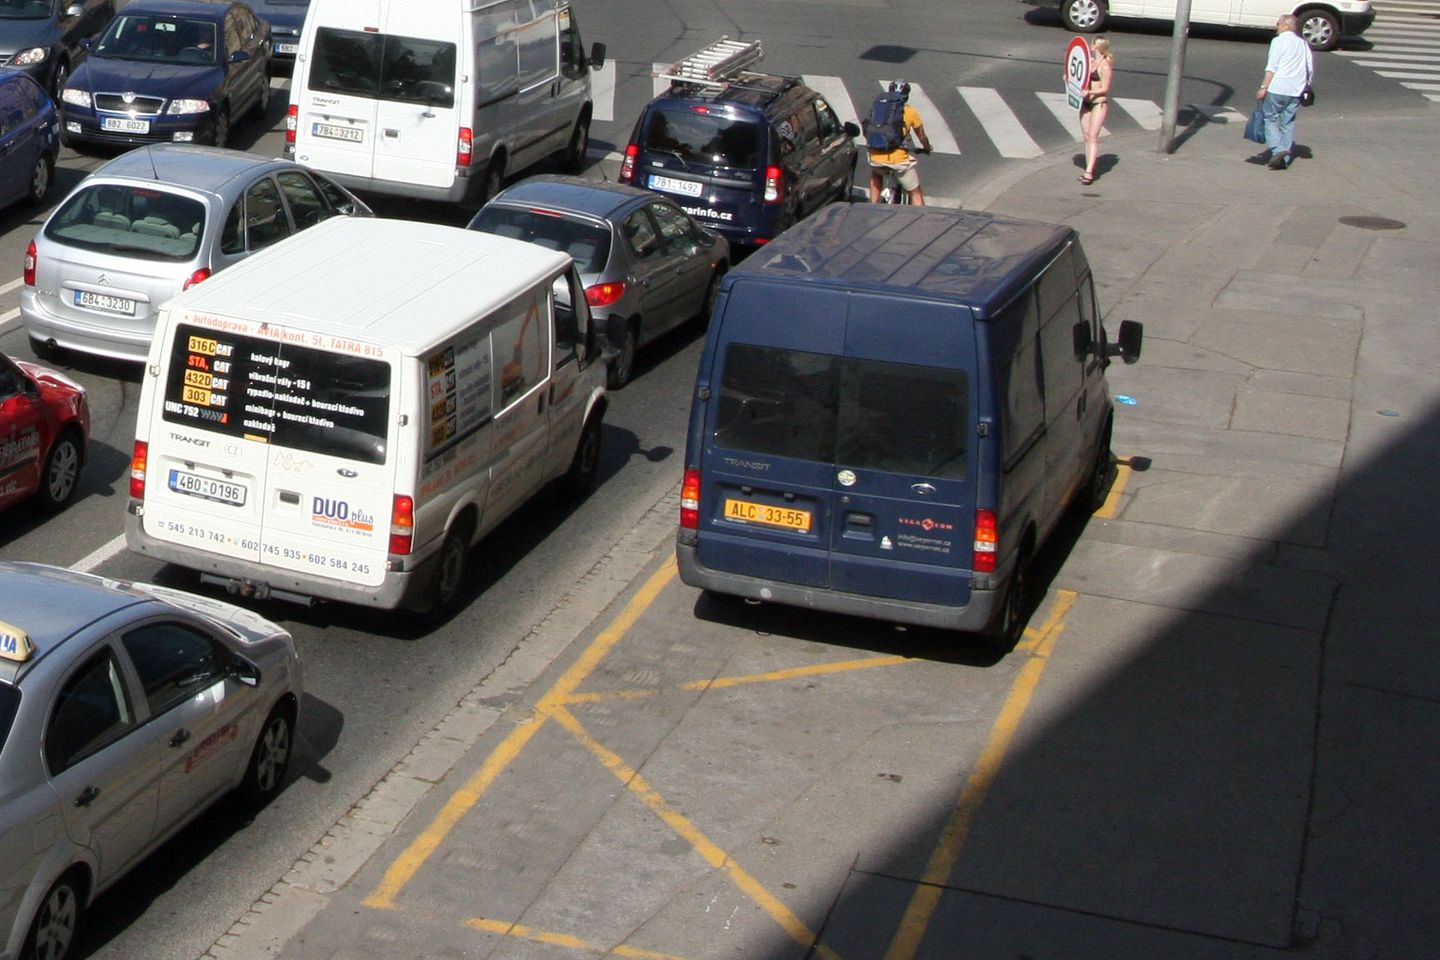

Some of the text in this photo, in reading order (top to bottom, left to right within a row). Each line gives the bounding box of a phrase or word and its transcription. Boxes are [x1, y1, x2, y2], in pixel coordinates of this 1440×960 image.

[1070, 55, 1084, 81] 50
[106, 296, 130, 311] 3230
[192, 314, 248, 333] autodoprava
[329, 338, 361, 354] TATRA
[363, 345, 384, 358] 815
[215, 342, 234, 357] CAT
[213, 359, 232, 373] CAT
[185, 371, 229, 390] 432D CAT
[187, 388, 227, 407] 303 CAT
[165, 399, 183, 415] UNC
[183, 404, 200, 418] 752
[168, 431, 212, 449] TRANSIT
[722, 456, 771, 471] TRANSIT
[209, 481, 240, 500] 0196
[312, 495, 349, 520] DUO
[351, 508, 374, 524] plus
[731, 502, 803, 526] ALC 33-55
[167, 521, 370, 574] 545 213 742 602 745 935 602 584 245
